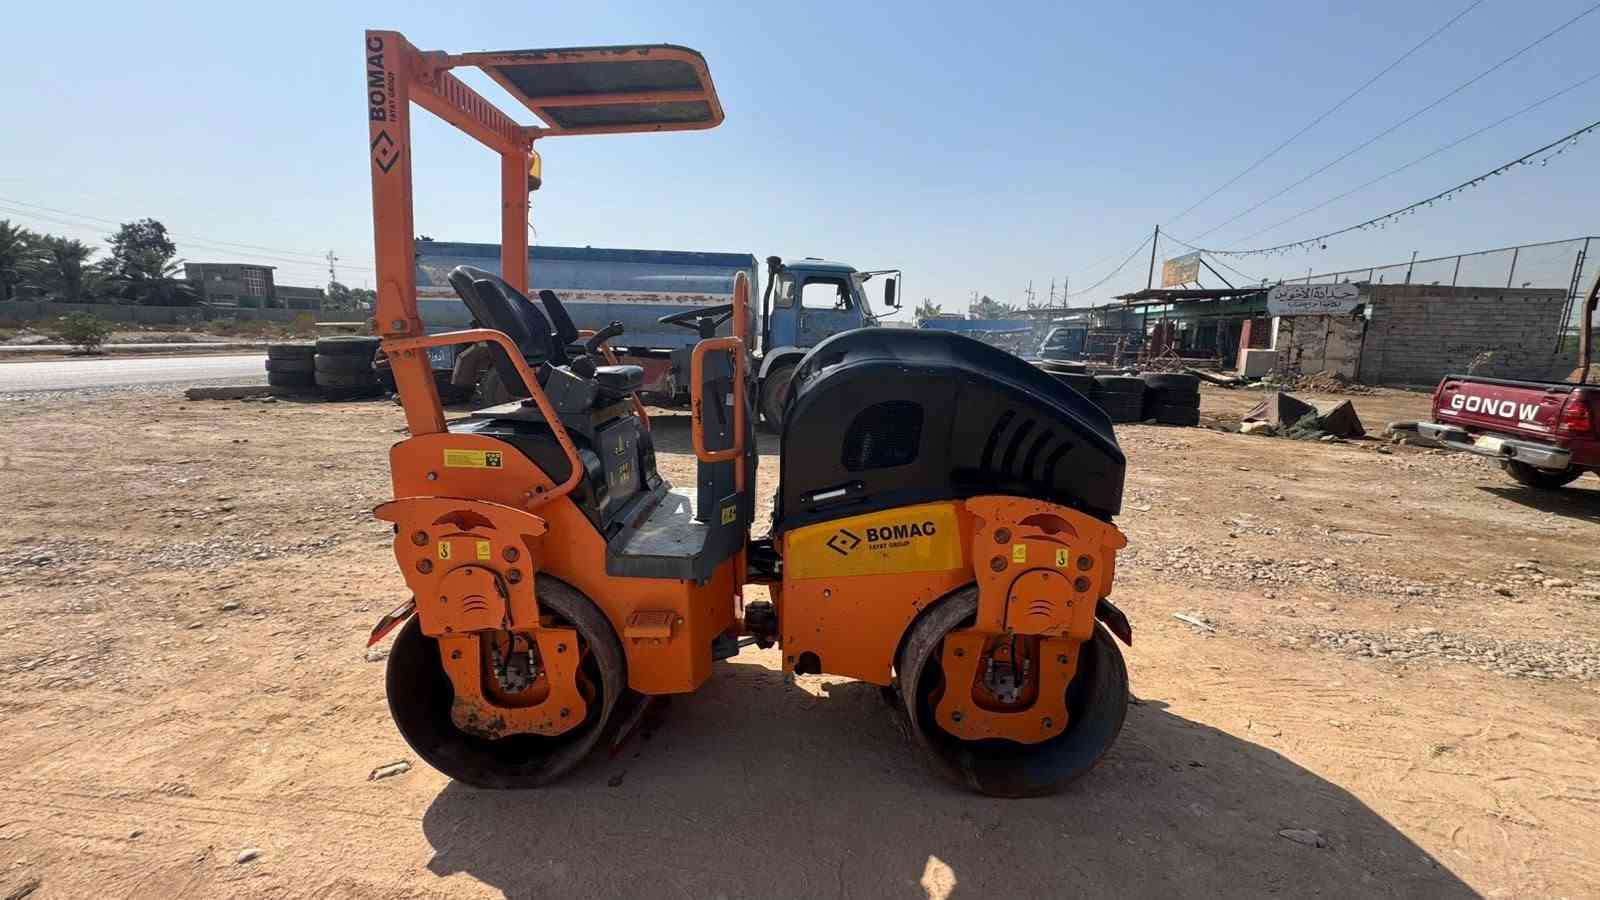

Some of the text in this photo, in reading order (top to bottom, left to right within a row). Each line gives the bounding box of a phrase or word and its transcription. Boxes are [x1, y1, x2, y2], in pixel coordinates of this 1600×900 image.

[367, 37, 386, 121] BOMAG
[1451, 394, 1540, 421] GONOW
[866, 521, 936, 542] BOMAG
